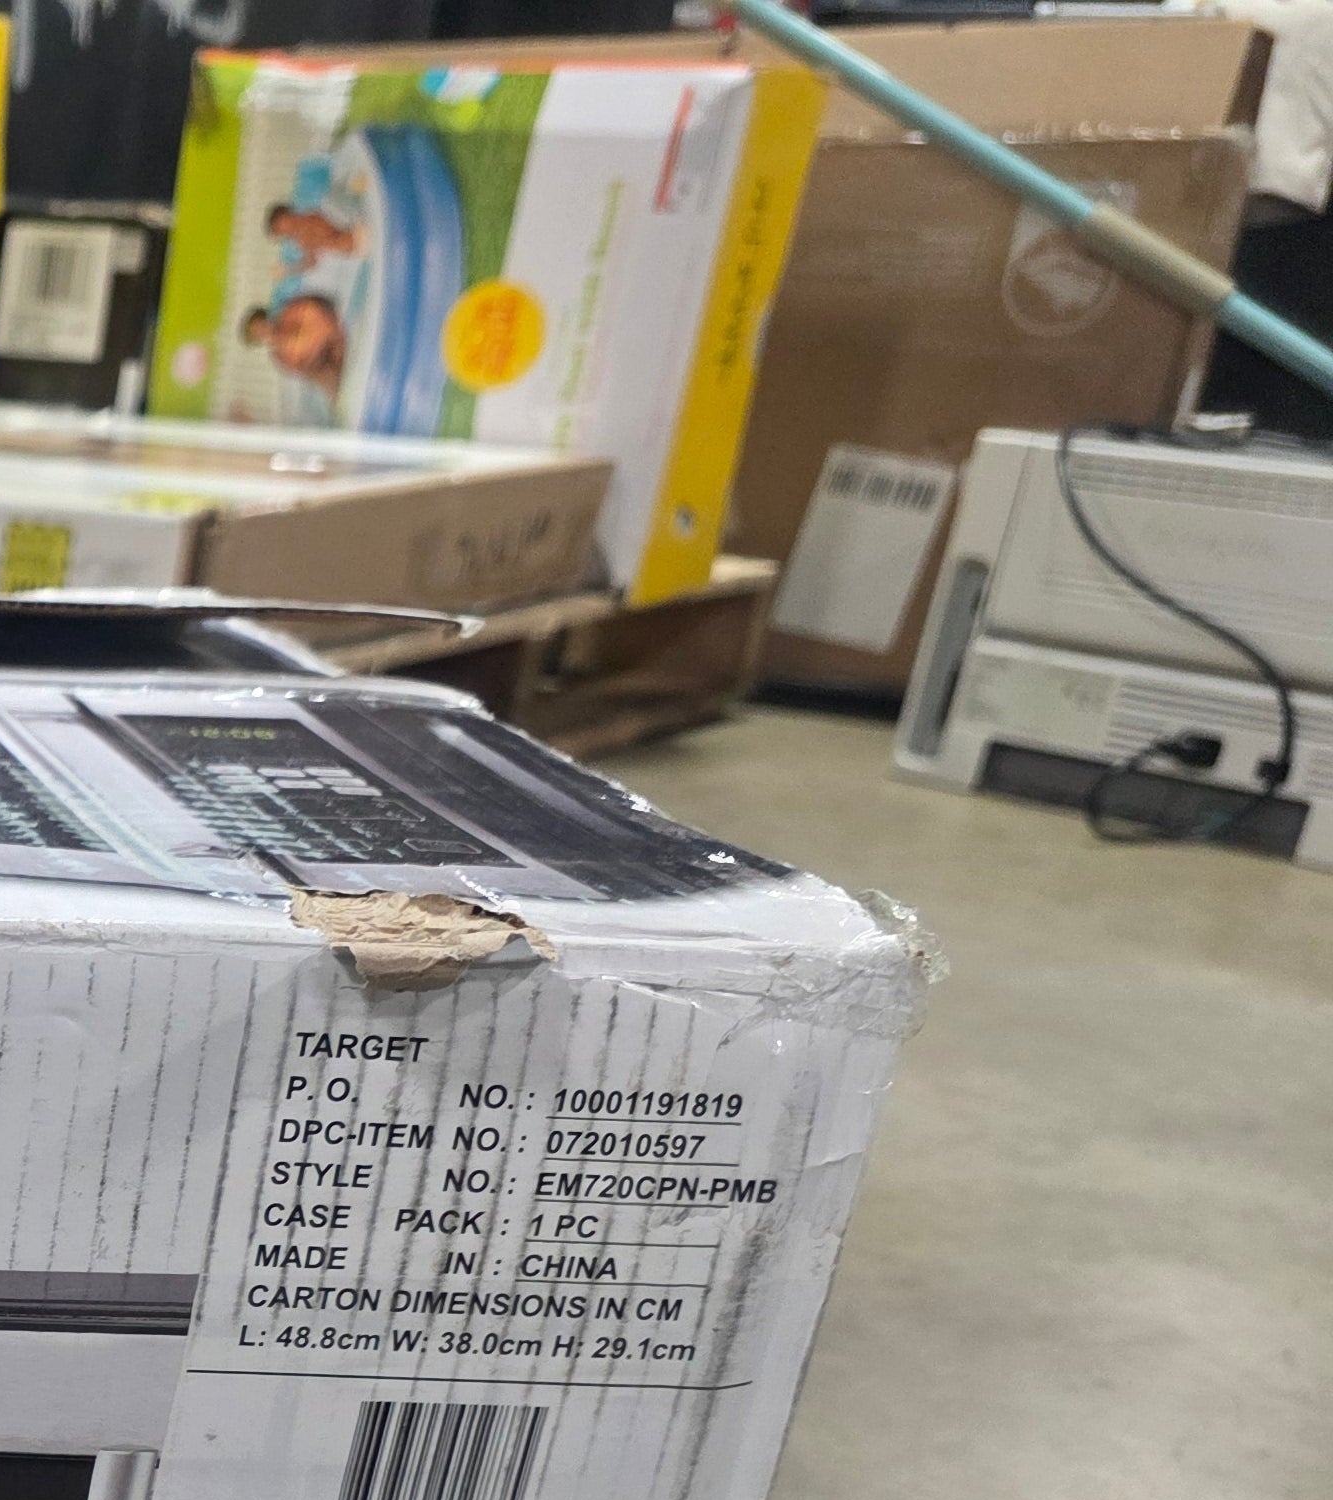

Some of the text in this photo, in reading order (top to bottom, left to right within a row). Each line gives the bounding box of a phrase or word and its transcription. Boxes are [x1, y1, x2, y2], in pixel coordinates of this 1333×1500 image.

[296, 1032, 429, 1062] TARGET
[554, 1088, 744, 1119] 10001191819
[278, 1118, 436, 1149] DPC-ITEM
[546, 1130, 707, 1160] 072010597
[271, 1161, 374, 1188] STYLE
[534, 1172, 778, 1204] EM720CPN-PMB
[263, 1202, 352, 1229] CASE
[394, 1208, 485, 1235] PACK
[530, 1214, 545, 1237] 1
[554, 1215, 600, 1239] PC
[254, 1244, 349, 1270] MADE
[442, 1251, 477, 1275] IN
[521, 1254, 618, 1280] CHINA
[247, 1284, 684, 1321] CARTON DIMENSIONS IN CM
[238, 1324, 697, 1361] L: 48.8cm W: 38.0cm H: 29.1cm
